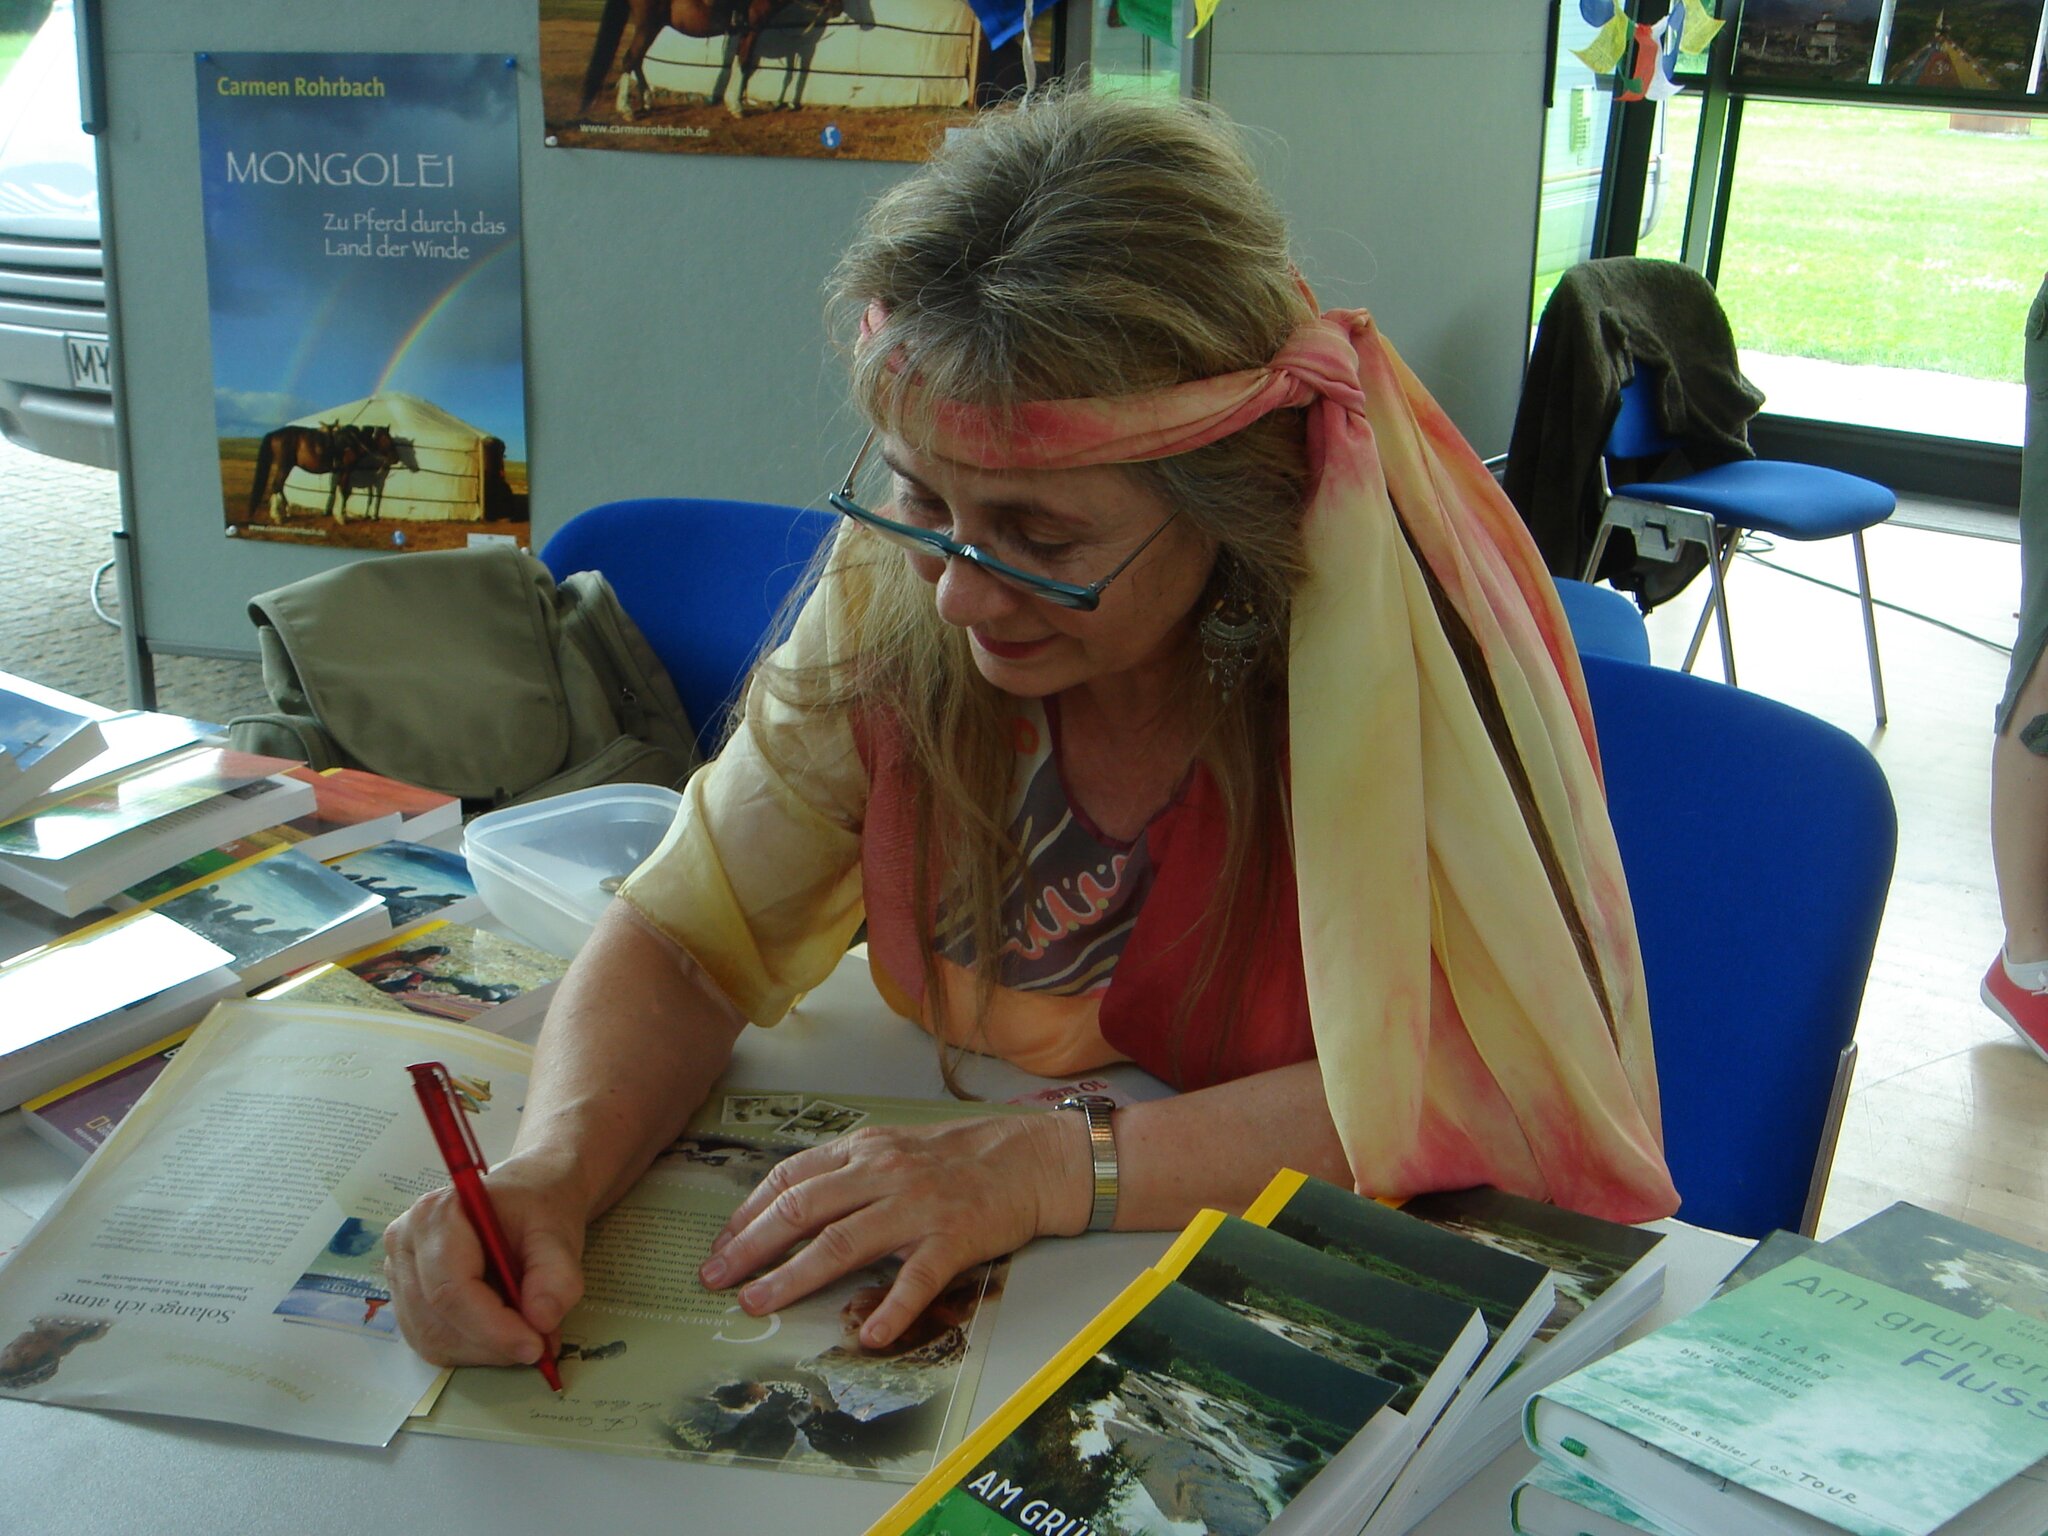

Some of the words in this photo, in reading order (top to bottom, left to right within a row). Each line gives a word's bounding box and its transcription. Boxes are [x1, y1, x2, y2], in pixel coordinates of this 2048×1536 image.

[216, 76, 290, 97] Carmen
[294, 76, 386, 98] Rohrbach
[579, 124, 710, 138] www.carmenrohrbach.de
[226, 150, 455, 188] MONGOLEI
[323, 212, 348, 231] Zu
[354, 207, 407, 232] Pferd
[411, 209, 466, 234] durch
[471, 211, 506, 234] das
[325, 233, 372, 257] Land
[376, 234, 408, 257] der
[412, 236, 470, 260] Winde
[55, 1292, 110, 1309] atme
[1782, 1276, 1869, 1311] Am
[114, 1299, 147, 1315] ich
[150, 1300, 236, 1324] Solange
[1716, 1332, 1748, 1347] eine
[1680, 1347, 1702, 1359] bis
[1705, 1358, 1730, 1370] zur
[1709, 1344, 1734, 1357] von
[1738, 1355, 1761, 1368] der
[1767, 1365, 1814, 1389] Quelle
[1620, 1398, 1688, 1433] Frederking
[1706, 1435, 1747, 1459] Thaler
[967, 1470, 1024, 1510] AM
[1019, 1500, 1097, 1536] GRÜ
